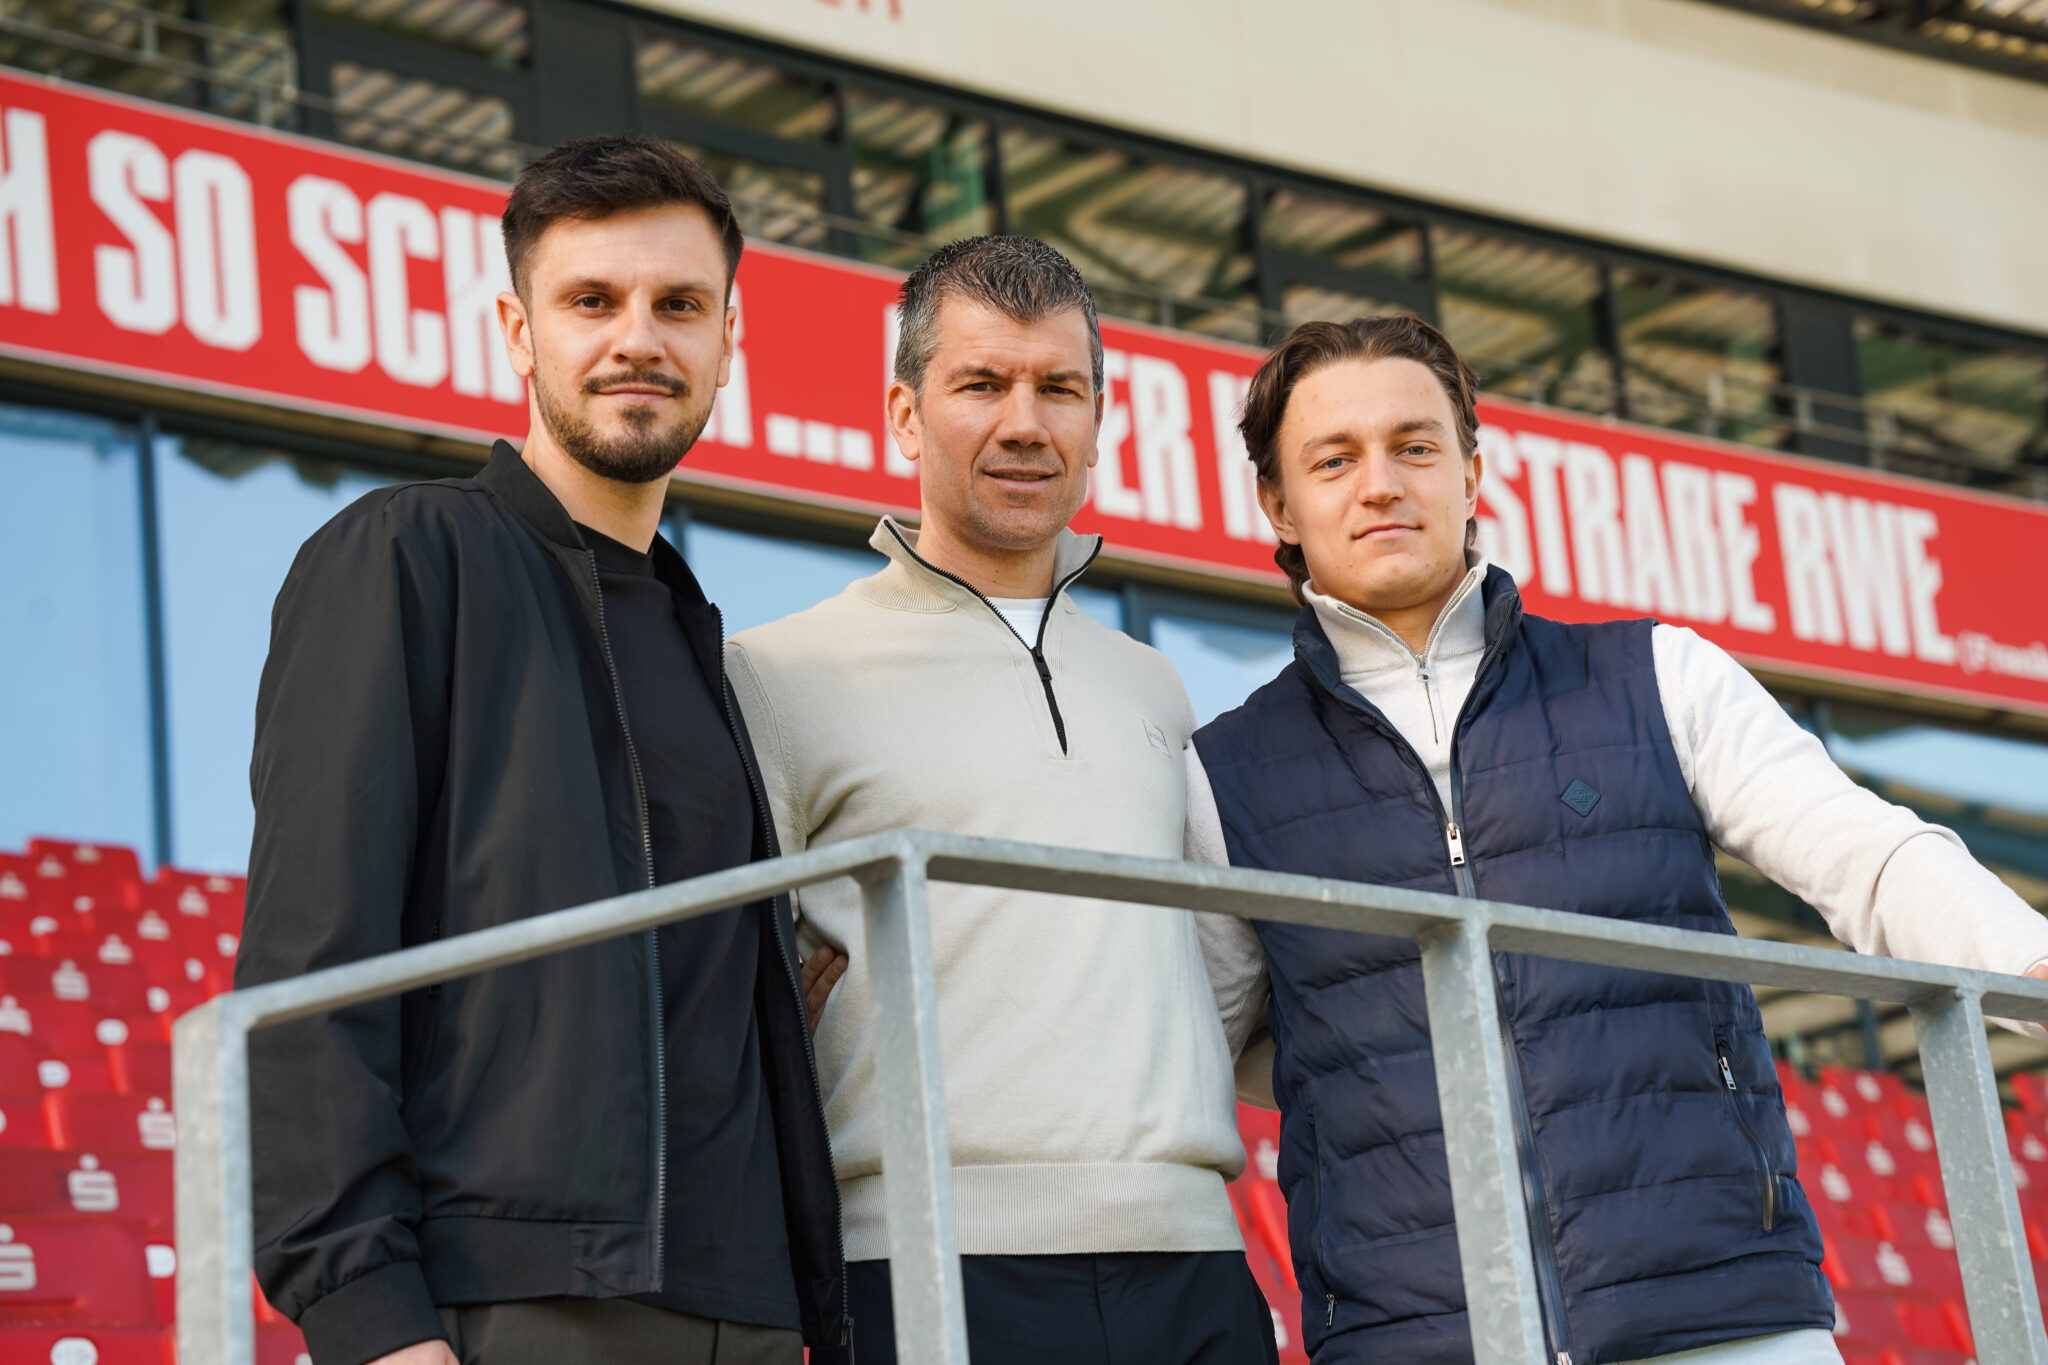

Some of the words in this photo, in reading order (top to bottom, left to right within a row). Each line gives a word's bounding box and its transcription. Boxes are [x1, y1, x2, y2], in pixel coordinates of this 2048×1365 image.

[86, 128, 263, 352] SO
[1086, 345, 1203, 533] ER
[1771, 481, 1956, 666] RWE
